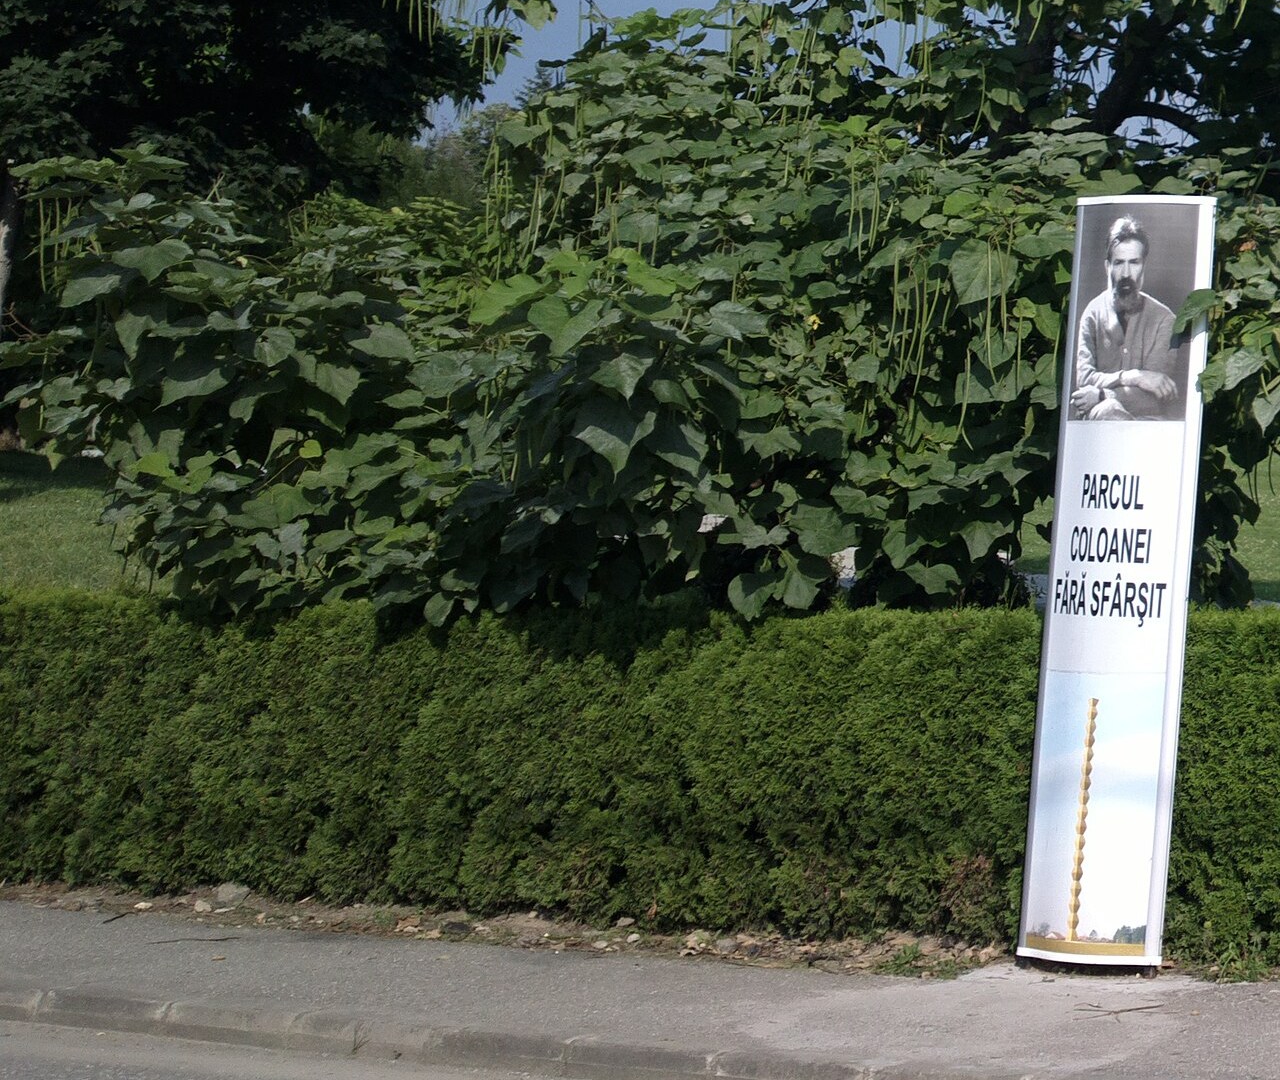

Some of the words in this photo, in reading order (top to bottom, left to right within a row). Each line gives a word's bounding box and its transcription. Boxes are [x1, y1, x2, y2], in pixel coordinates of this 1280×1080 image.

[1081, 473, 1144, 510] PARCUL
[1070, 525, 1152, 564] COLOANEI
[1054, 571, 1087, 616] FĂRĂ
